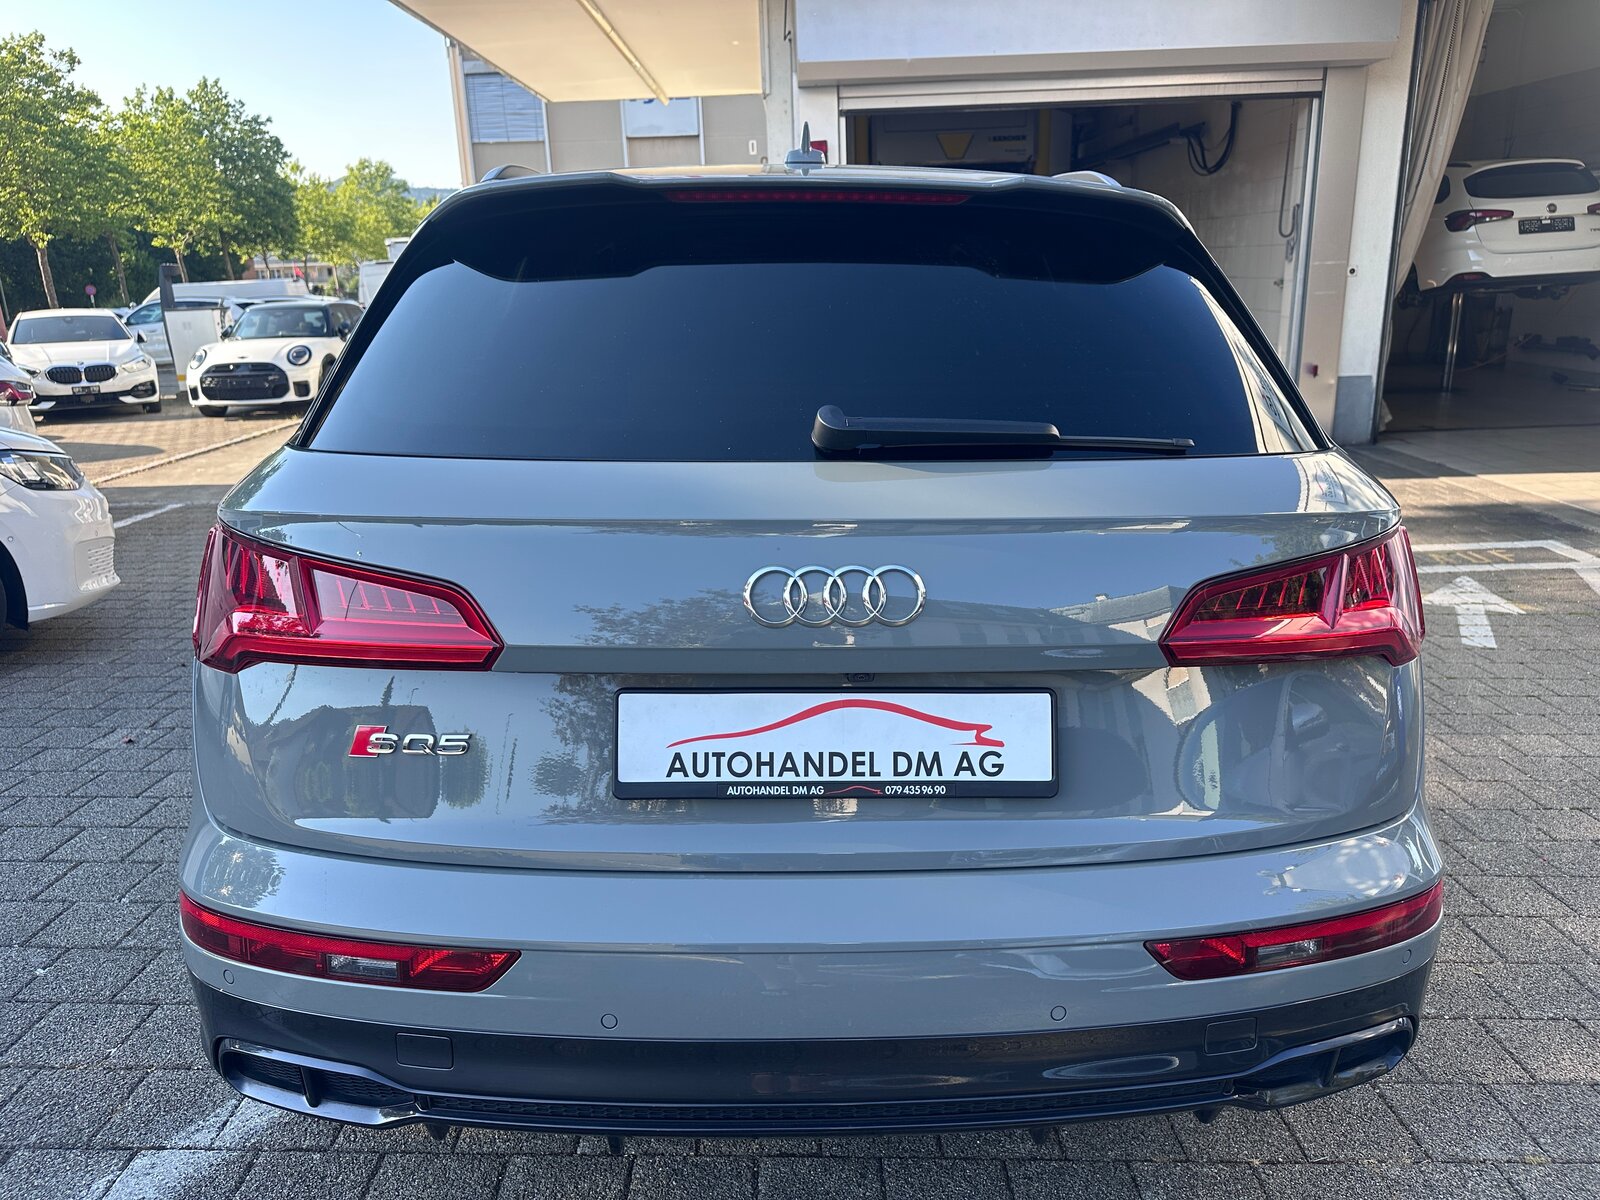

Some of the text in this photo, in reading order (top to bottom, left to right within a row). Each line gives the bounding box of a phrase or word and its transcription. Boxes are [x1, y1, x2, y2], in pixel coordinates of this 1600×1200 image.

[366, 733, 472, 755] SQ5
[666, 750, 1005, 778] AUTOHANDEL DM AG
[726, 785, 824, 795] AUTOHANDEL DM AG
[885, 785, 947, 795] 079 435 96 90
